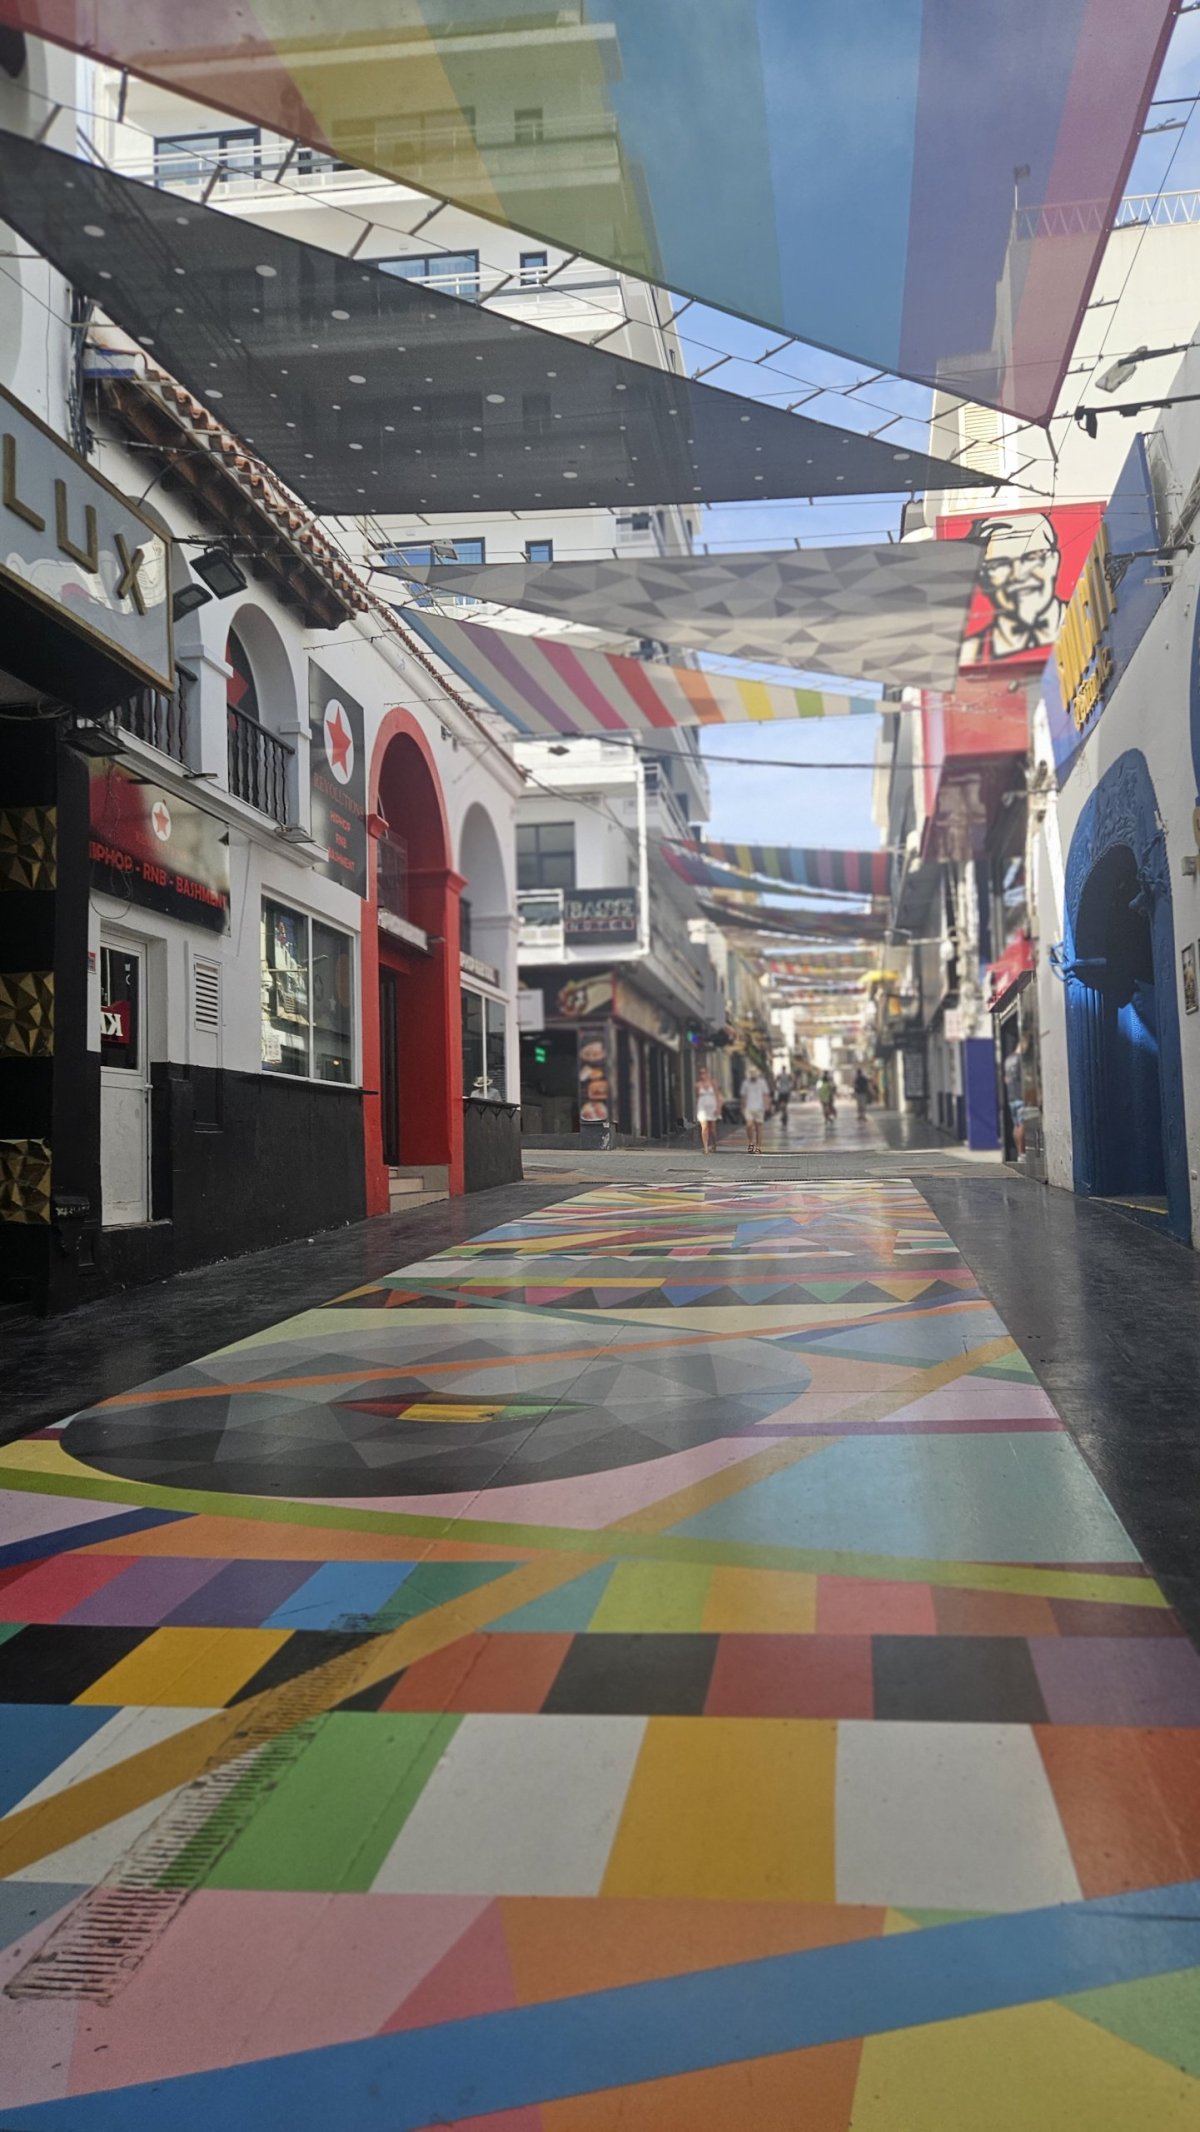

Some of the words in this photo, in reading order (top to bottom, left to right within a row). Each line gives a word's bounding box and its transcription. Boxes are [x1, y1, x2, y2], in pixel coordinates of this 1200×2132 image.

[3, 432, 146, 617] LUX
[143, 862, 167, 887] RNB
[176, 876, 227, 910] BASHMENT
